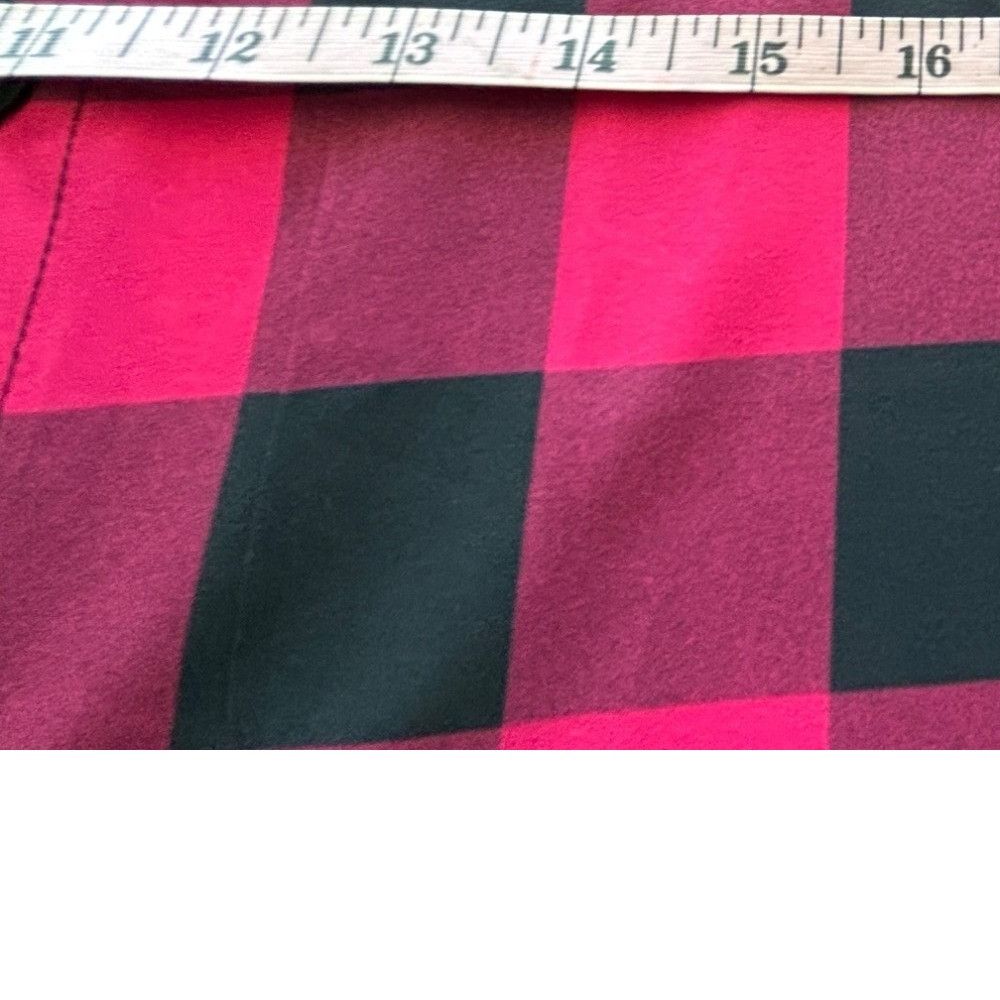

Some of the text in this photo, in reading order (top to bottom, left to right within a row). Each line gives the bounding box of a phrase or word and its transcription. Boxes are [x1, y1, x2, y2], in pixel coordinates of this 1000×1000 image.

[0, 27, 67, 58] 11
[187, 31, 265, 63] 12
[372, 31, 438, 65] 13
[553, 38, 617, 73] 14
[728, 41, 788, 75] 15
[896, 44, 951, 79] 16
